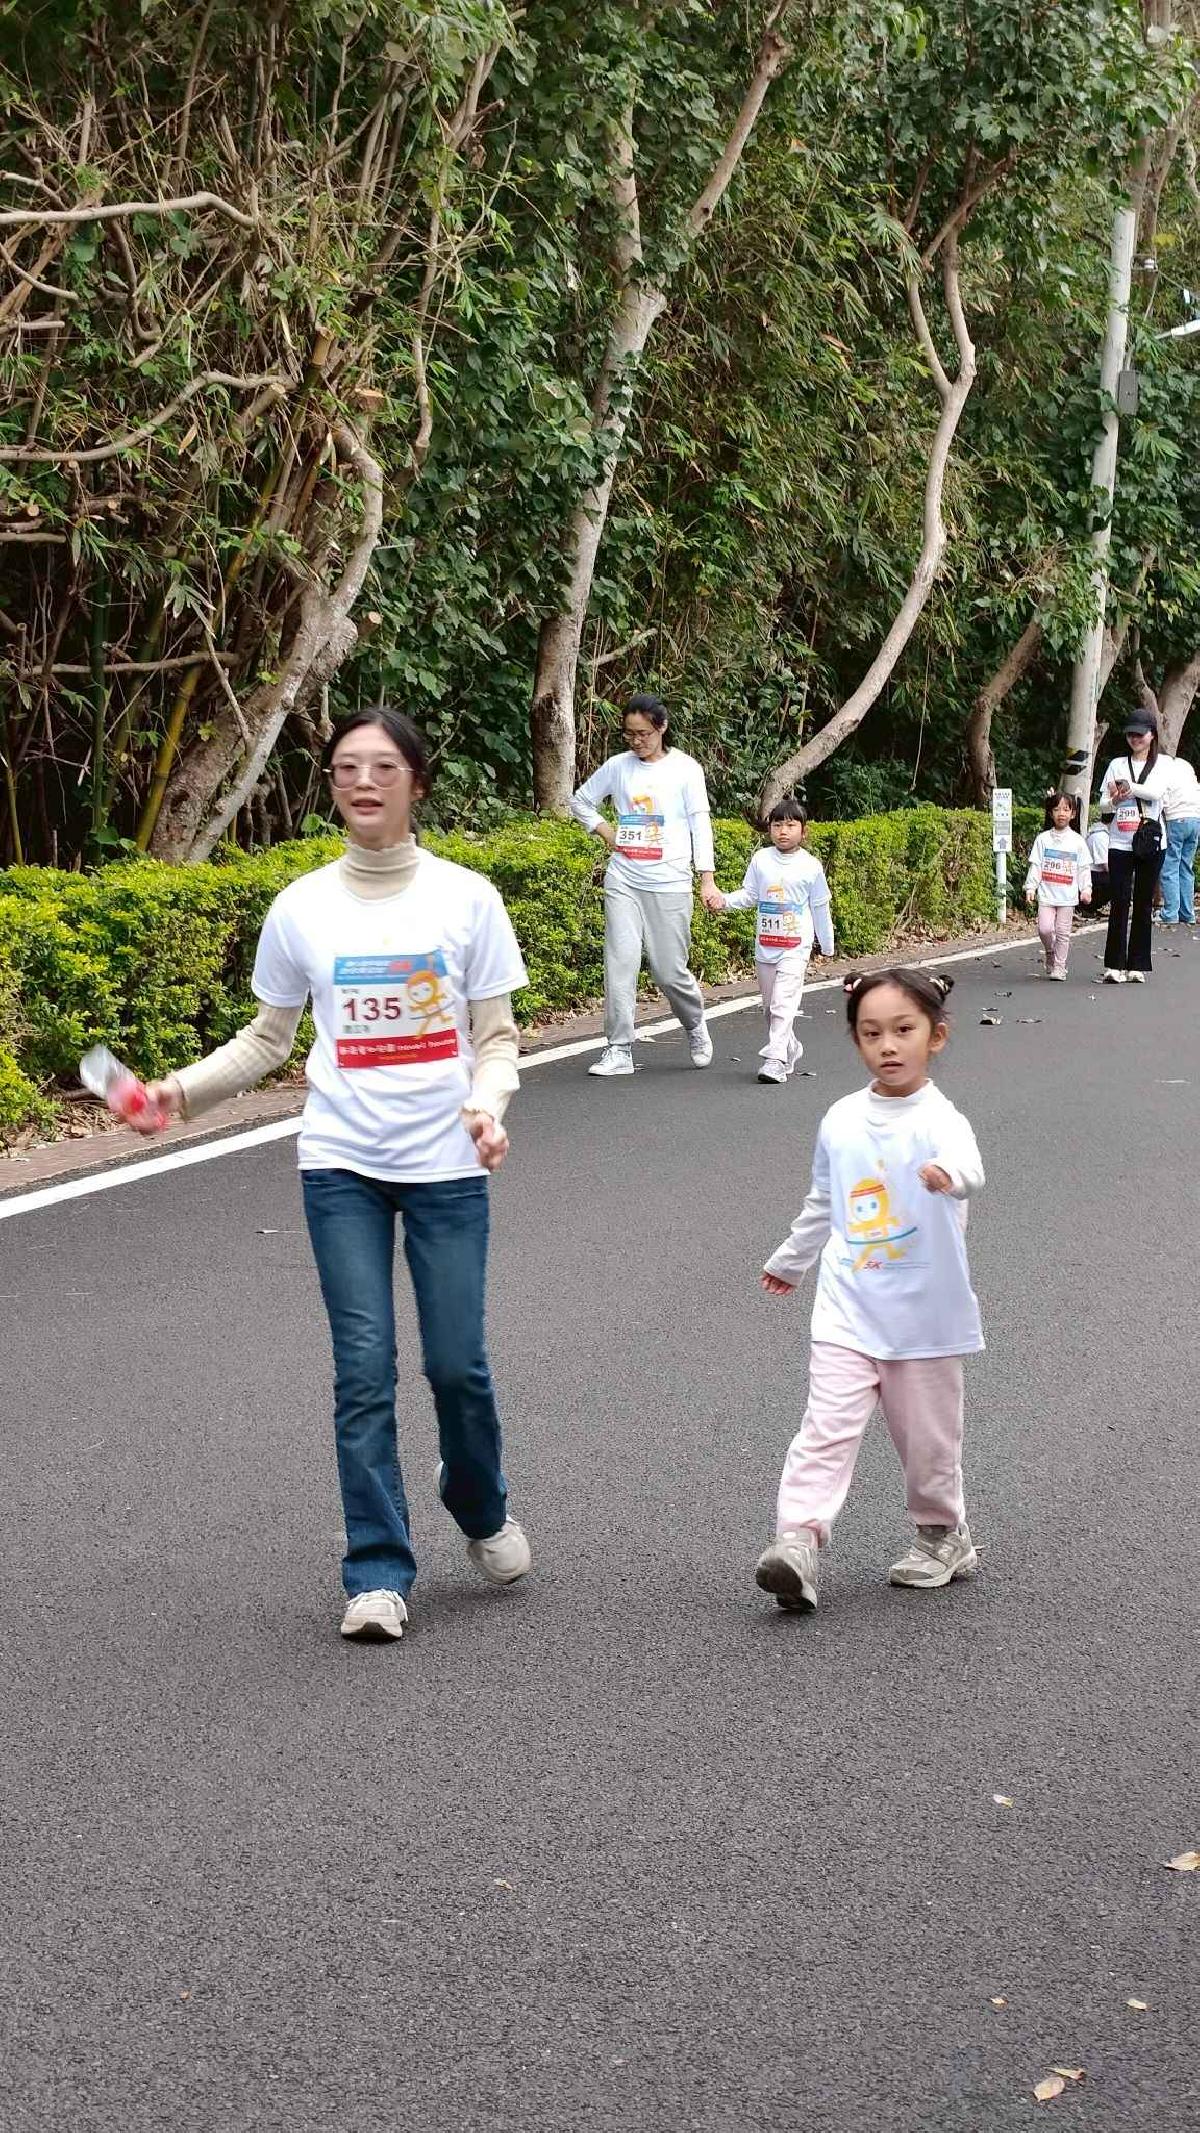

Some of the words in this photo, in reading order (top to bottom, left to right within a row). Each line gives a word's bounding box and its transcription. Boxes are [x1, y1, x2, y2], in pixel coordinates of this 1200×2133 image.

[619, 830, 642, 840] 351
[761, 918, 780, 929] 511
[343, 997, 402, 1021] 135
